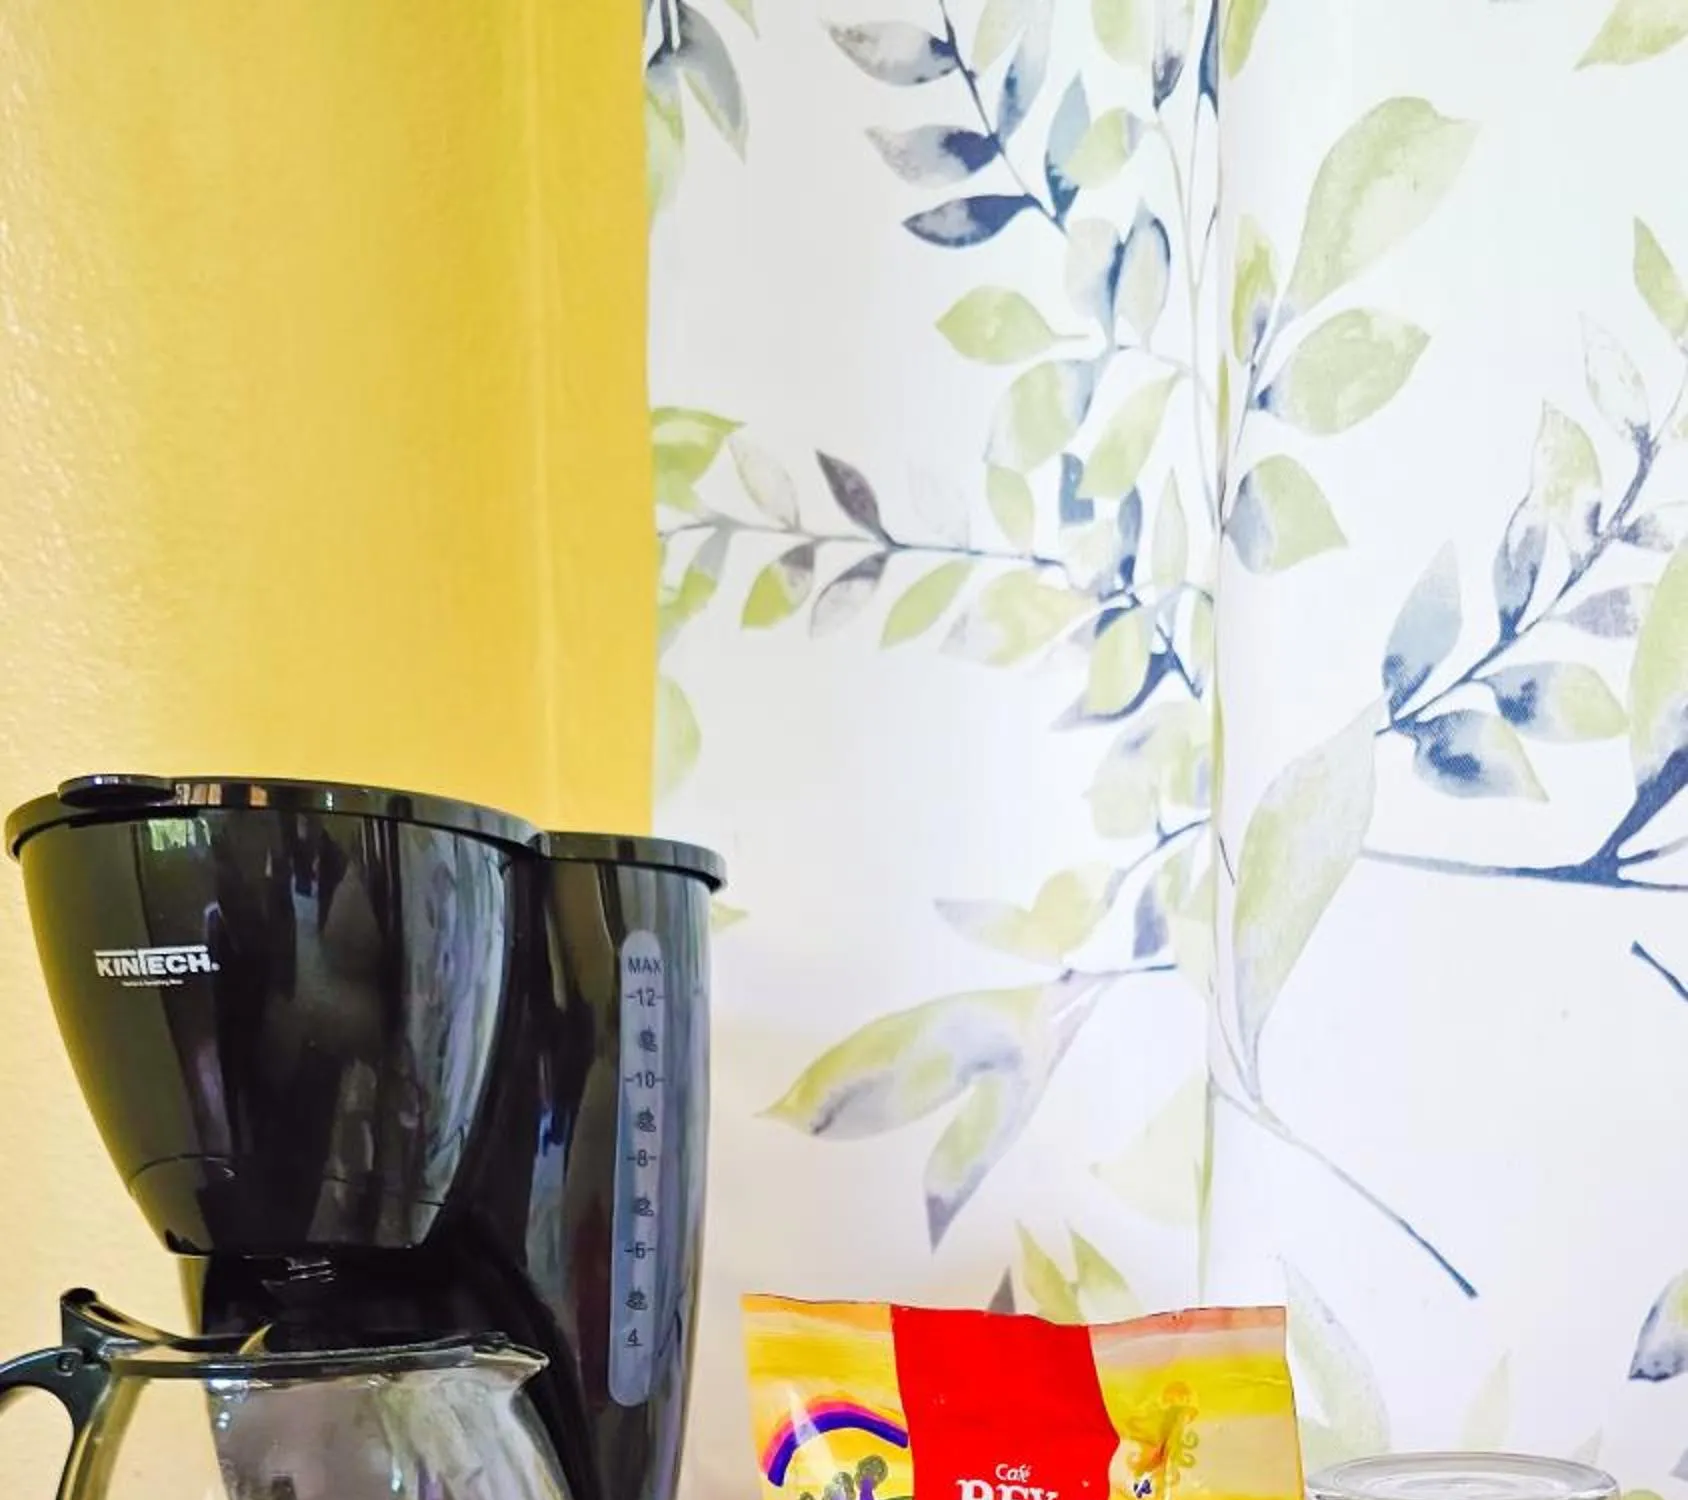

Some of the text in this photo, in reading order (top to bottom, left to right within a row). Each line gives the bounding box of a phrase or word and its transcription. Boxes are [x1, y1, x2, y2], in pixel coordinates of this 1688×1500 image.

[627, 957, 663, 974] MAX
[636, 986, 656, 1007] 12
[635, 1071, 656, 1089] 10
[637, 1149, 648, 1167] 8
[635, 1242, 646, 1259] 6
[627, 1328, 639, 1345] 4
